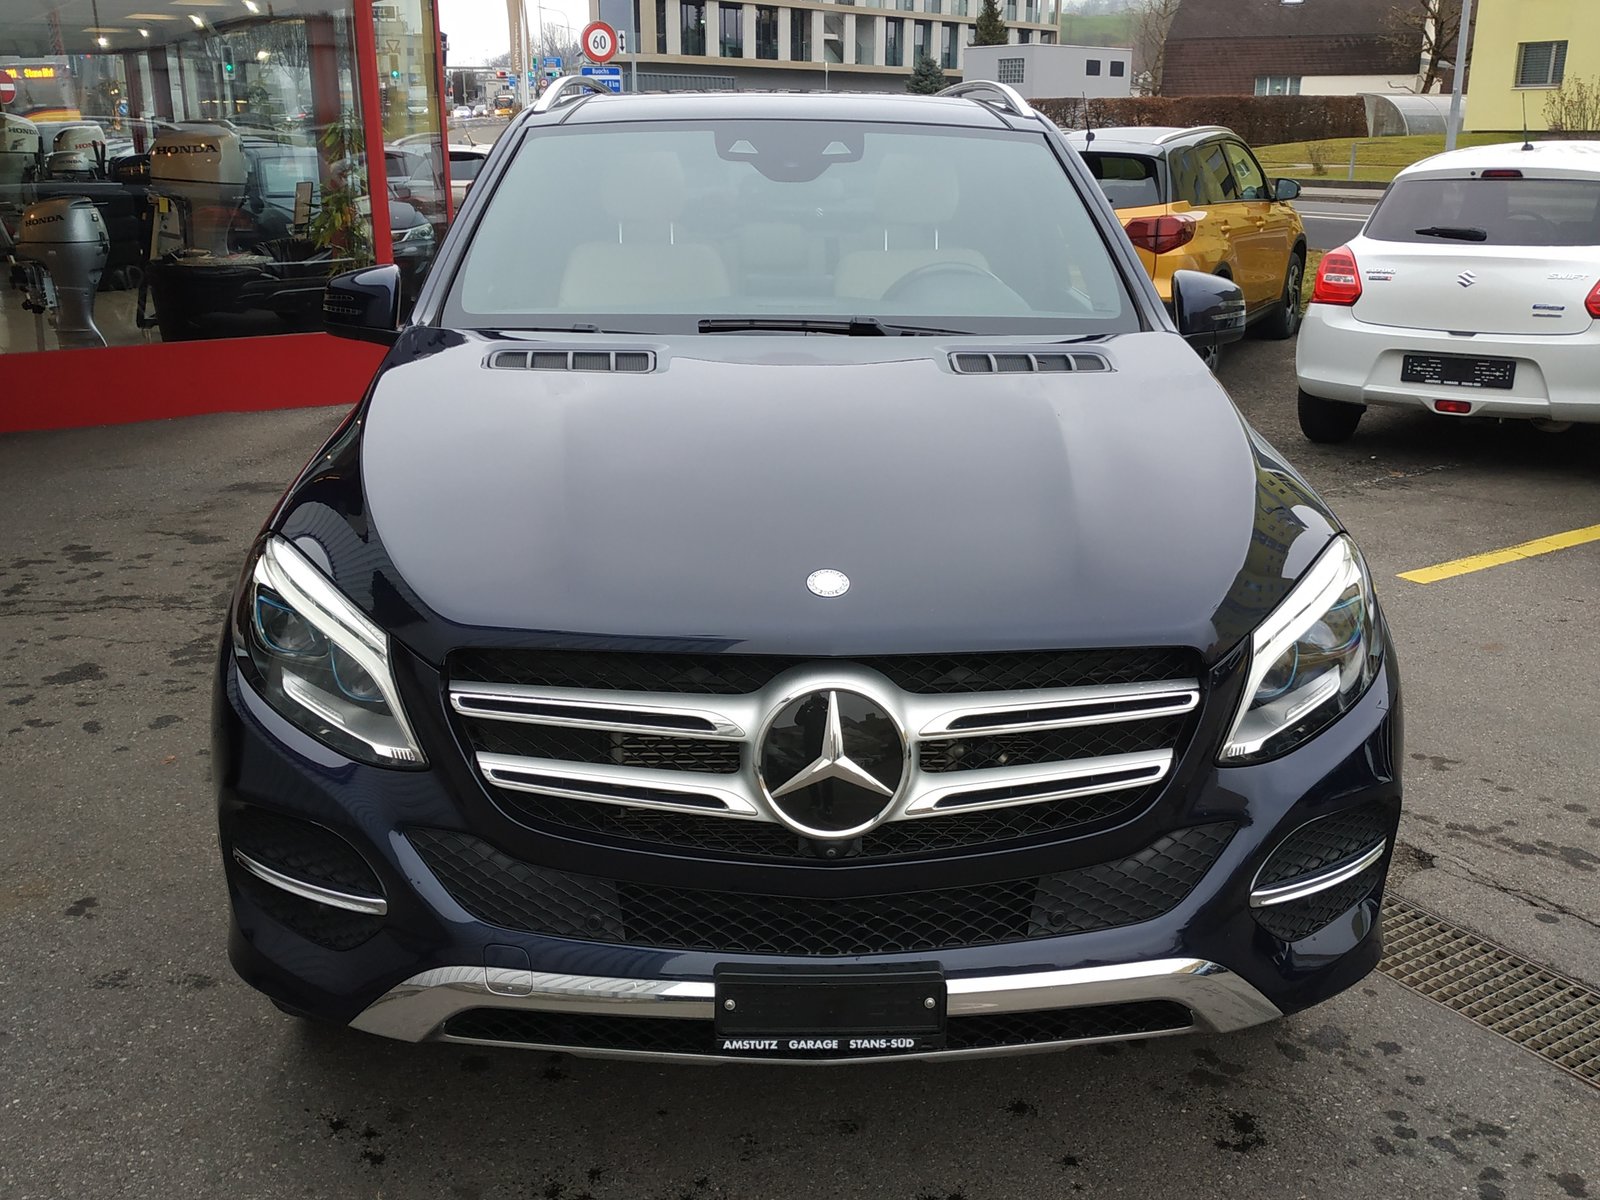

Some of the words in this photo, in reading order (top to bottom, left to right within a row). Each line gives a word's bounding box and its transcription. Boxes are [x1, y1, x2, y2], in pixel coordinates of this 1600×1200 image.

[593, 35, 606, 49] 60
[8, 127, 38, 135] HONDA
[156, 144, 217, 154] HONDA
[25, 215, 64, 226] HONDA
[1547, 272, 1590, 281] SWIFT
[722, 1040, 778, 1050] AMSTUTZ
[788, 1040, 839, 1050] GARAGE
[849, 1038, 915, 1049] STANS-SÜD
